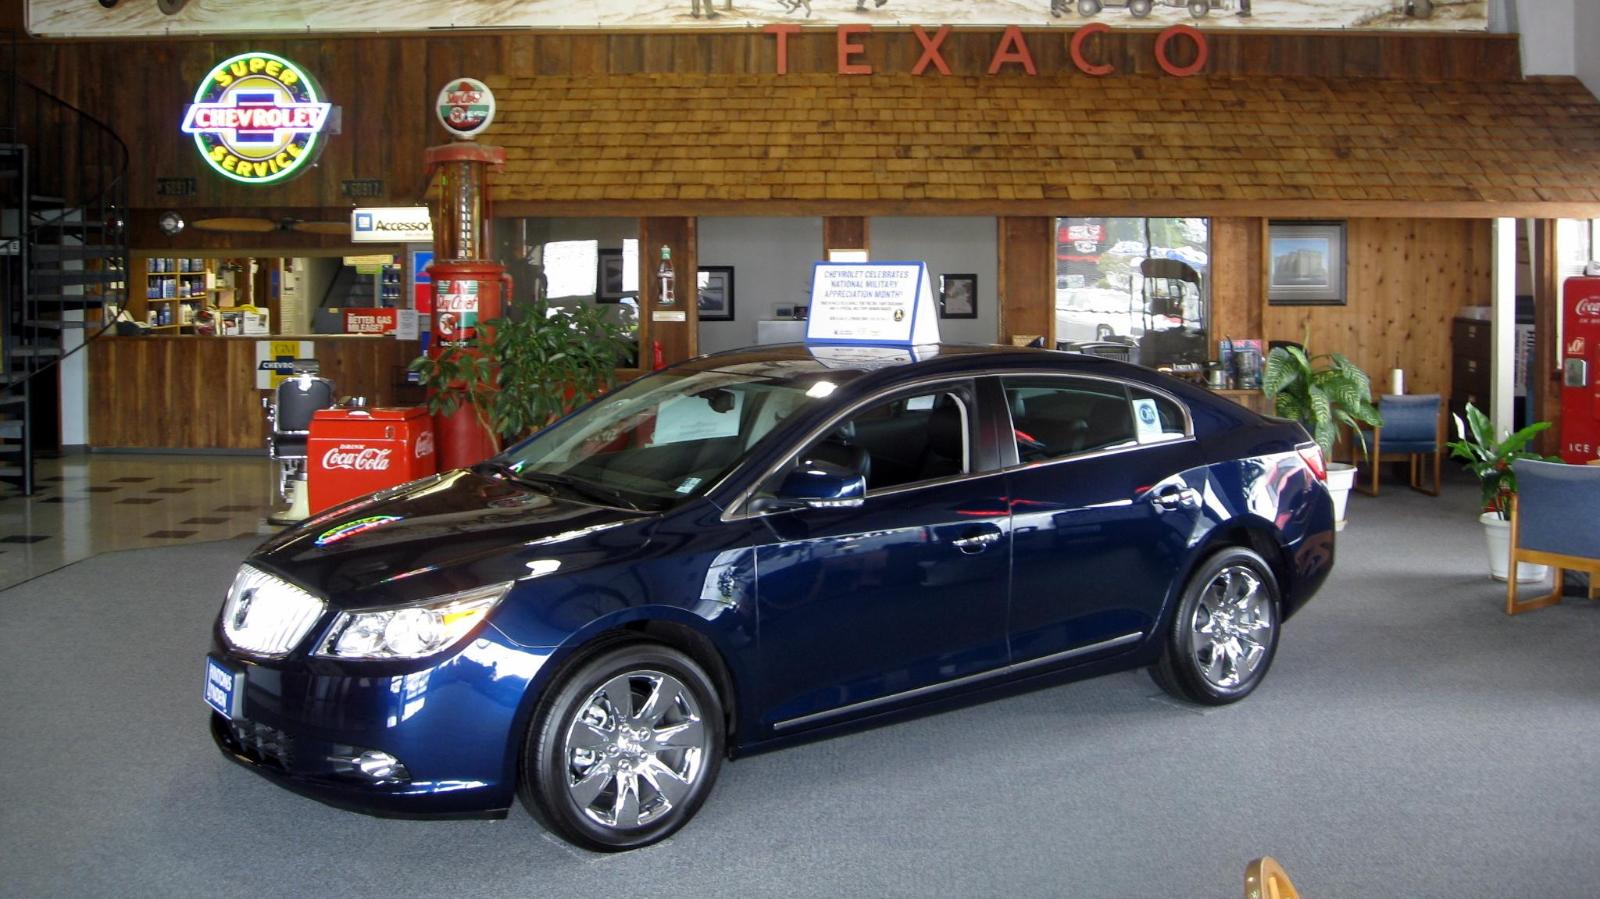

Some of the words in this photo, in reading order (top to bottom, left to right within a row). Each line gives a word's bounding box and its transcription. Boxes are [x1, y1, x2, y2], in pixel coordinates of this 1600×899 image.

[763, 23, 1208, 77] TEXACO
[213, 58, 298, 87] SUPER
[195, 108, 321, 128] CHEVROLET
[208, 144, 303, 177] SERVICE
[375, 219, 431, 232] Accessor
[824, 270, 863, 279] CHEVROLET
[865, 270, 909, 279] CELEBRATES
[831, 280, 863, 288] NATIONAL
[866, 280, 898, 288] MILITARY
[825, 290, 872, 298] APPRECIATION
[347, 315, 375, 324] BETTER
[376, 315, 392, 324] GAS
[1568, 443, 1591, 453] ICE
[322, 448, 392, 470] Coca-Cola
